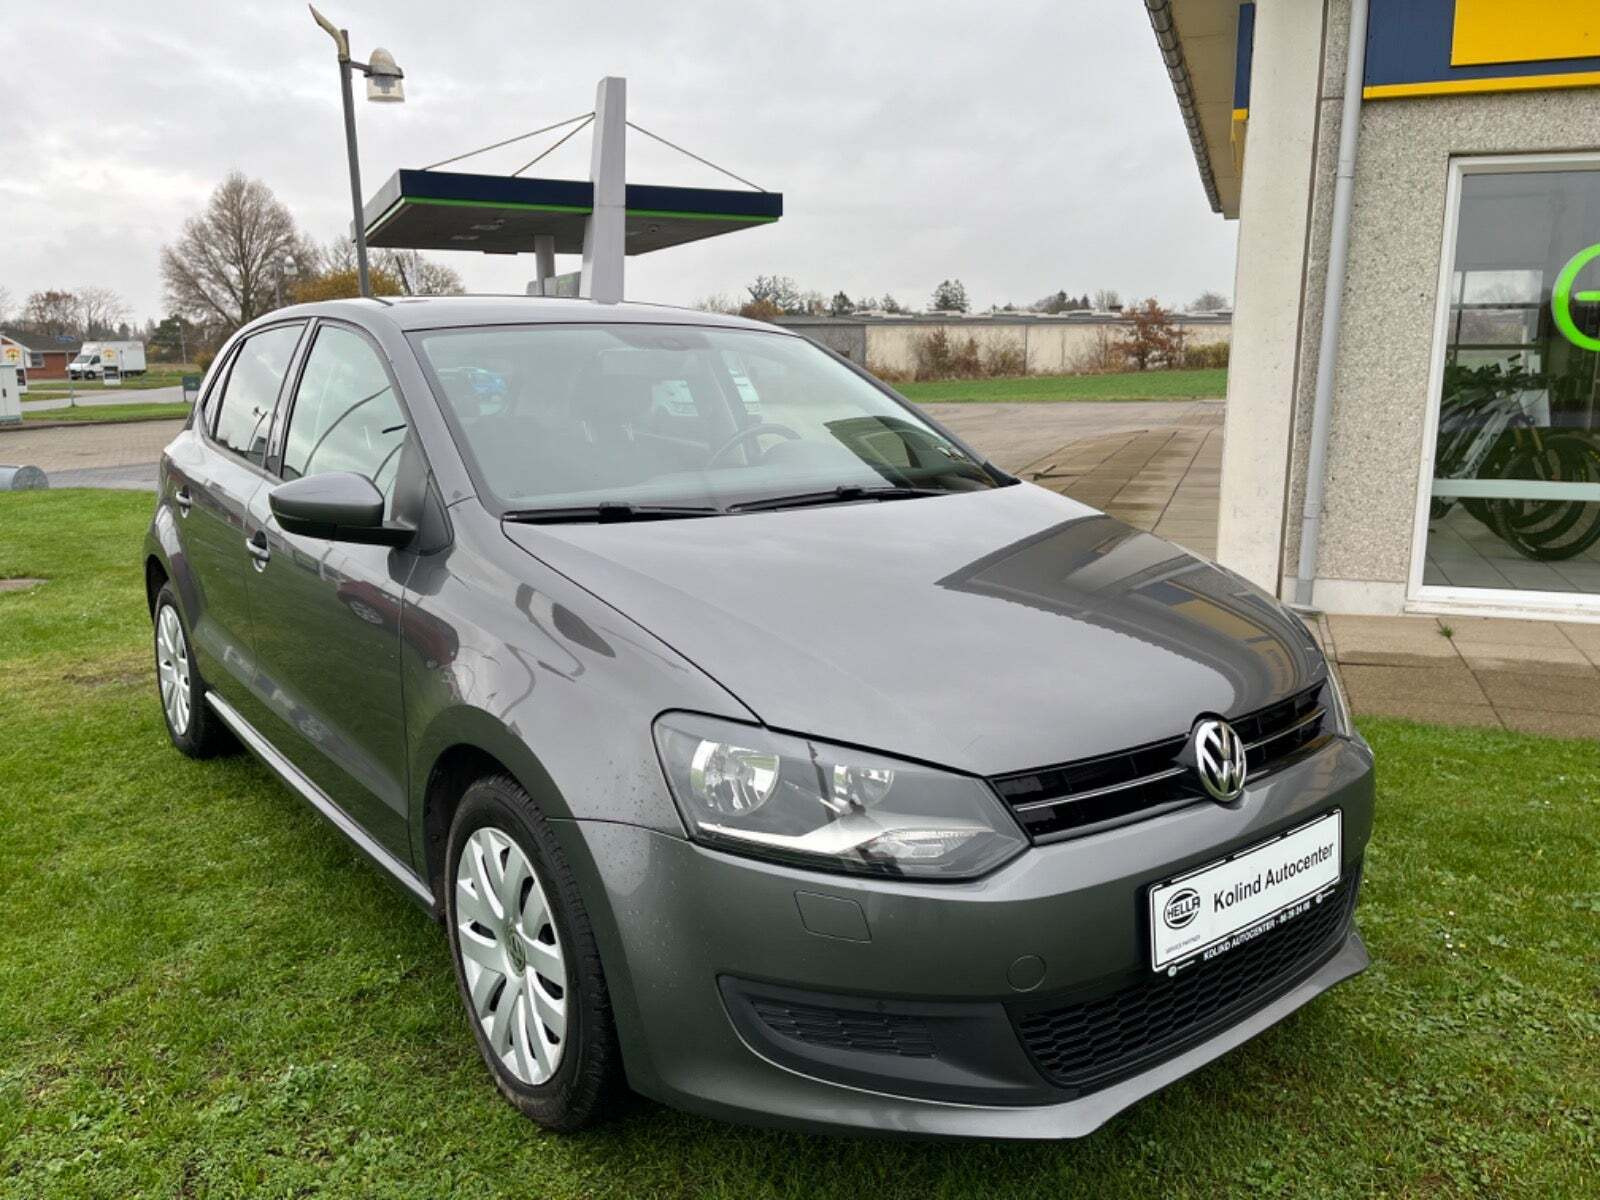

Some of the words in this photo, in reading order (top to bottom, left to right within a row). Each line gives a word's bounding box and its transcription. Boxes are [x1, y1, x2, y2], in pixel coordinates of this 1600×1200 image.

[1213, 873, 1261, 913] Kolind
[1265, 843, 1334, 889] Autocenter
[1167, 896, 1201, 920] HELLA
[1203, 941, 1231, 961] KOLIND
